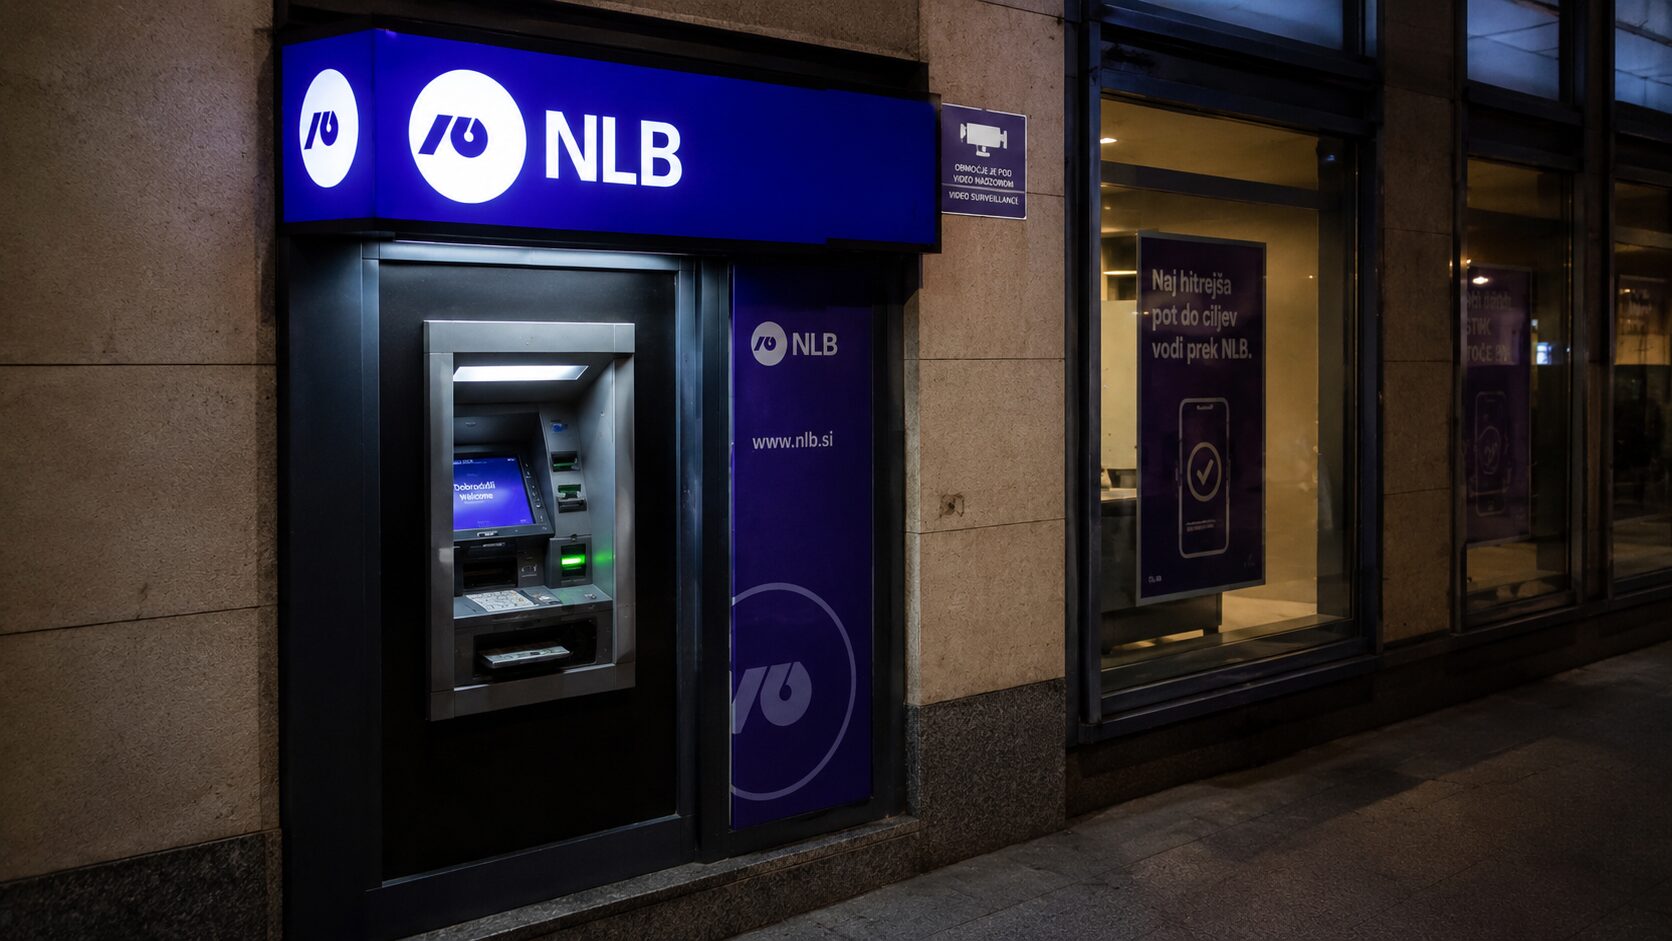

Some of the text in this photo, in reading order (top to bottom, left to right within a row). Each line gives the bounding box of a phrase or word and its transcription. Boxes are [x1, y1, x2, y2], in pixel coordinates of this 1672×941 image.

[546, 110, 682, 187] NLB
[953, 174, 974, 184] VIDEO
[998, 168, 1012, 178] POD
[949, 191, 1019, 206] VIDEO SURVEILLANCE
[1152, 268, 1232, 300] Naj hitrejša
[1152, 302, 1238, 332] pot do ciljev
[793, 333, 837, 355] NLB
[1152, 336, 1252, 365] vodi prek NLB.
[753, 431, 832, 449] www.nlb.si
